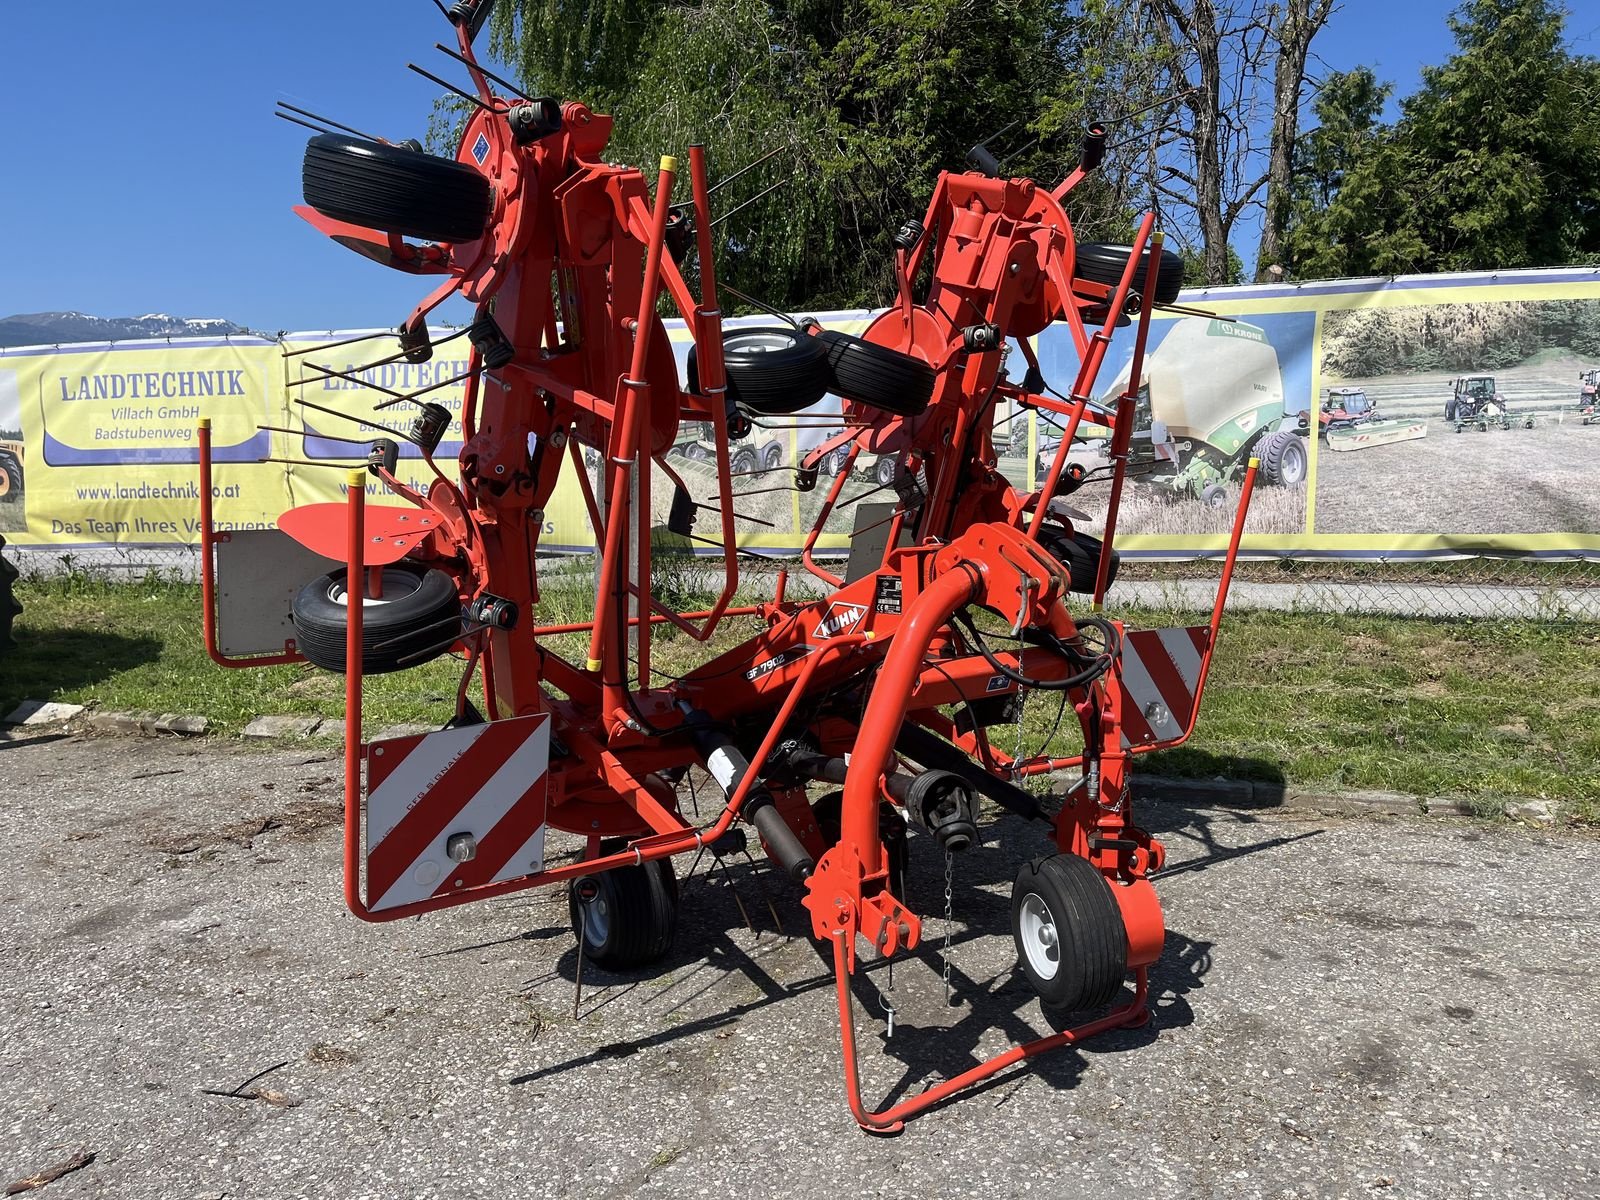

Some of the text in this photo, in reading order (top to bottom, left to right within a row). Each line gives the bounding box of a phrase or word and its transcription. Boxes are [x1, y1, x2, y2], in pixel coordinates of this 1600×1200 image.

[1233, 328, 1262, 341] KRONE
[59, 369, 245, 401] LANDTECHNIK
[111, 405, 200, 420] Villach GmbH
[94, 427, 192, 441] Badstubenweg
[51, 519, 82, 535] Das
[86, 518, 130, 535] Team
[135, 518, 178, 533] Ihres
[820, 606, 860, 637] KUHN
[746, 653, 785, 680] GF 7902
